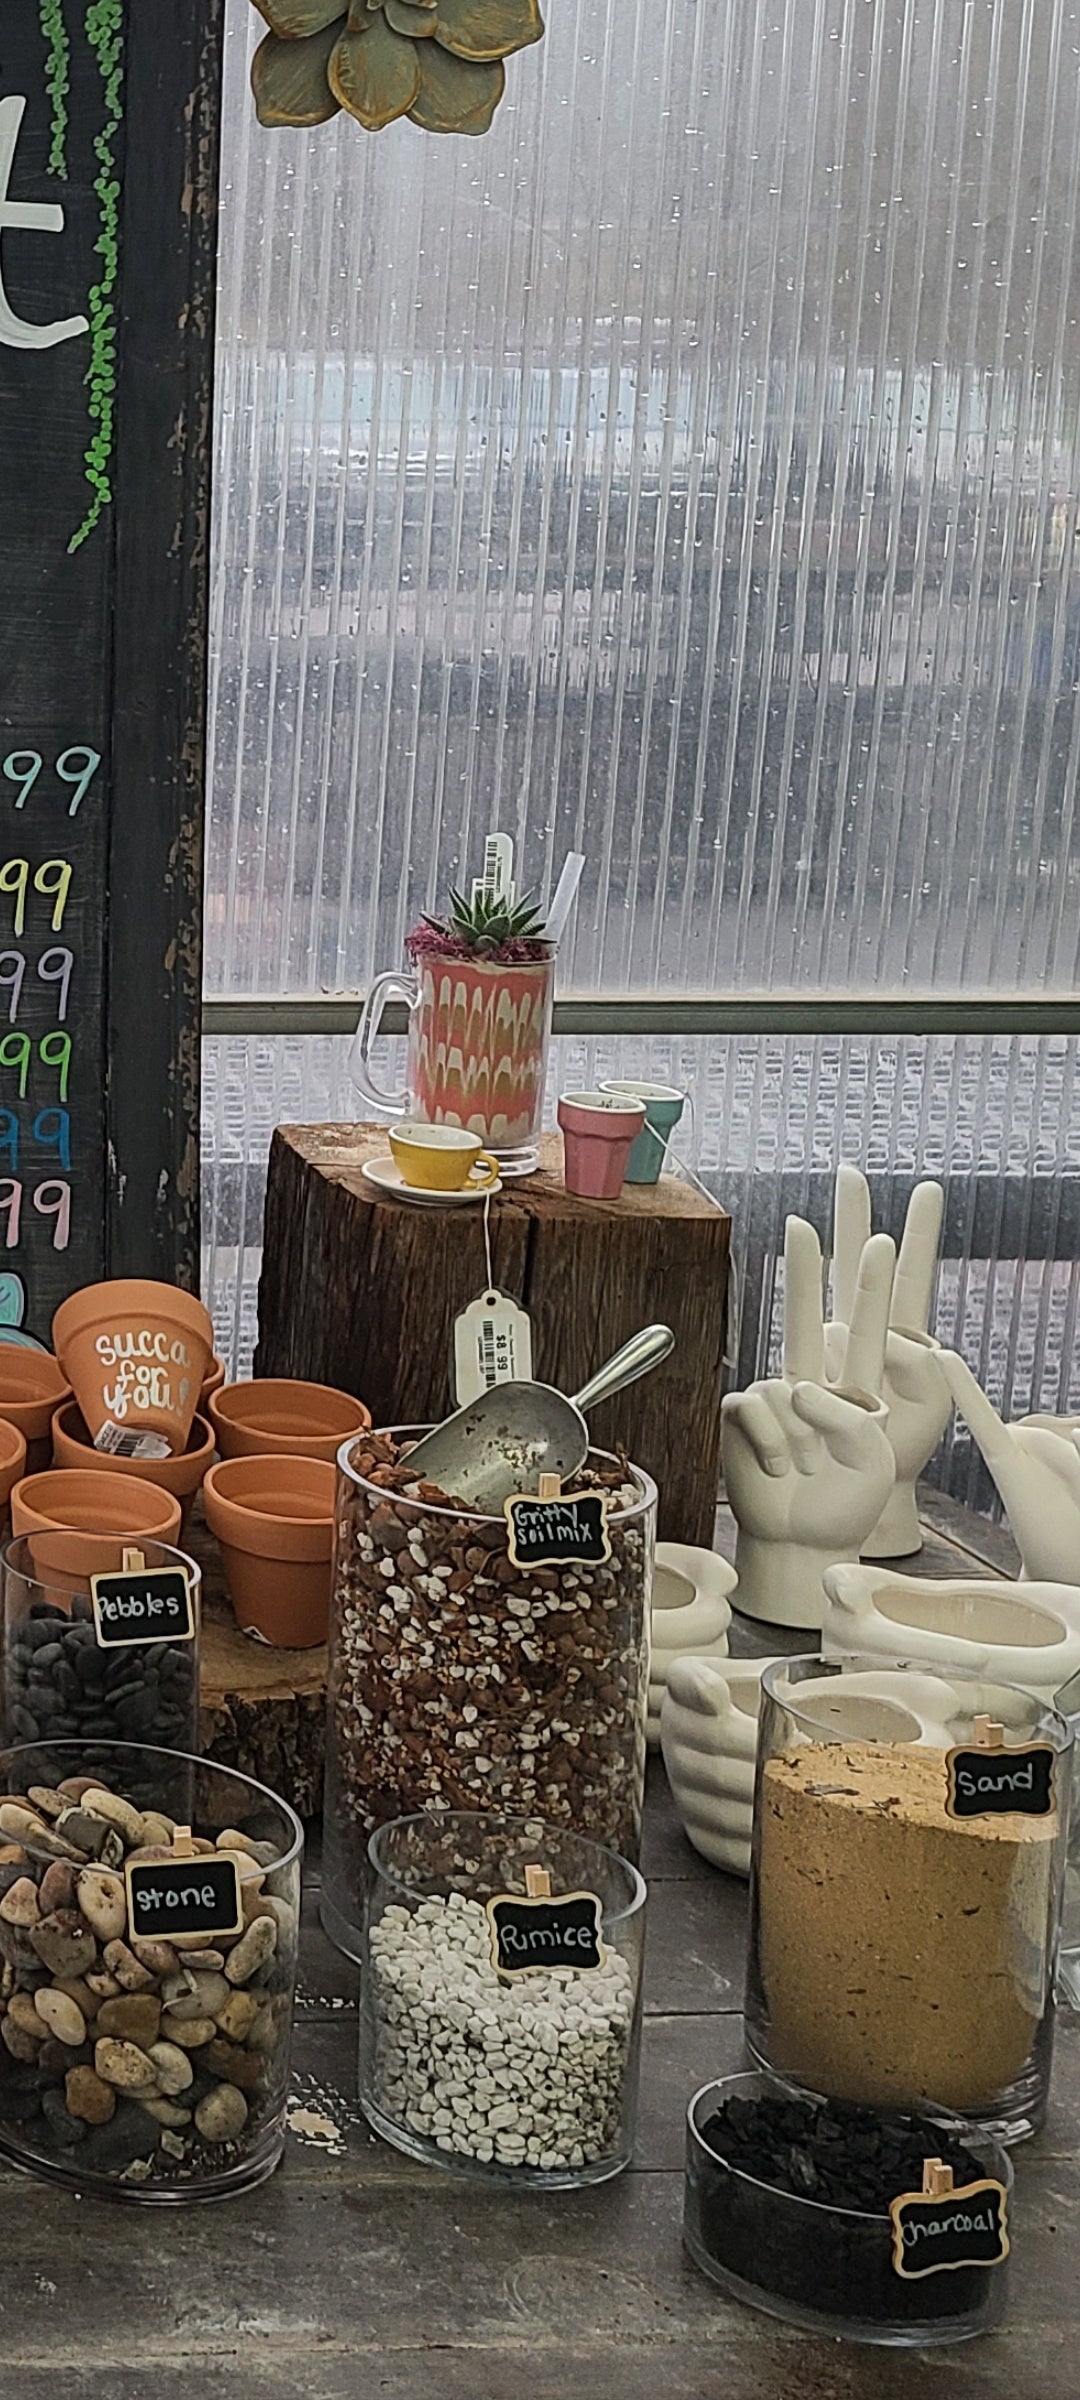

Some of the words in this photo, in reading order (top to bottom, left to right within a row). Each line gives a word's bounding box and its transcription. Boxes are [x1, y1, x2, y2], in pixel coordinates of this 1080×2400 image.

[496, 1334, 509, 1371] $899
[116, 1360, 168, 1392] for
[103, 1378, 190, 1419] you!
[514, 1504, 578, 1529] Gritty
[97, 1592, 180, 1622] Pebbles
[500, 1922, 593, 1955] Pumice
